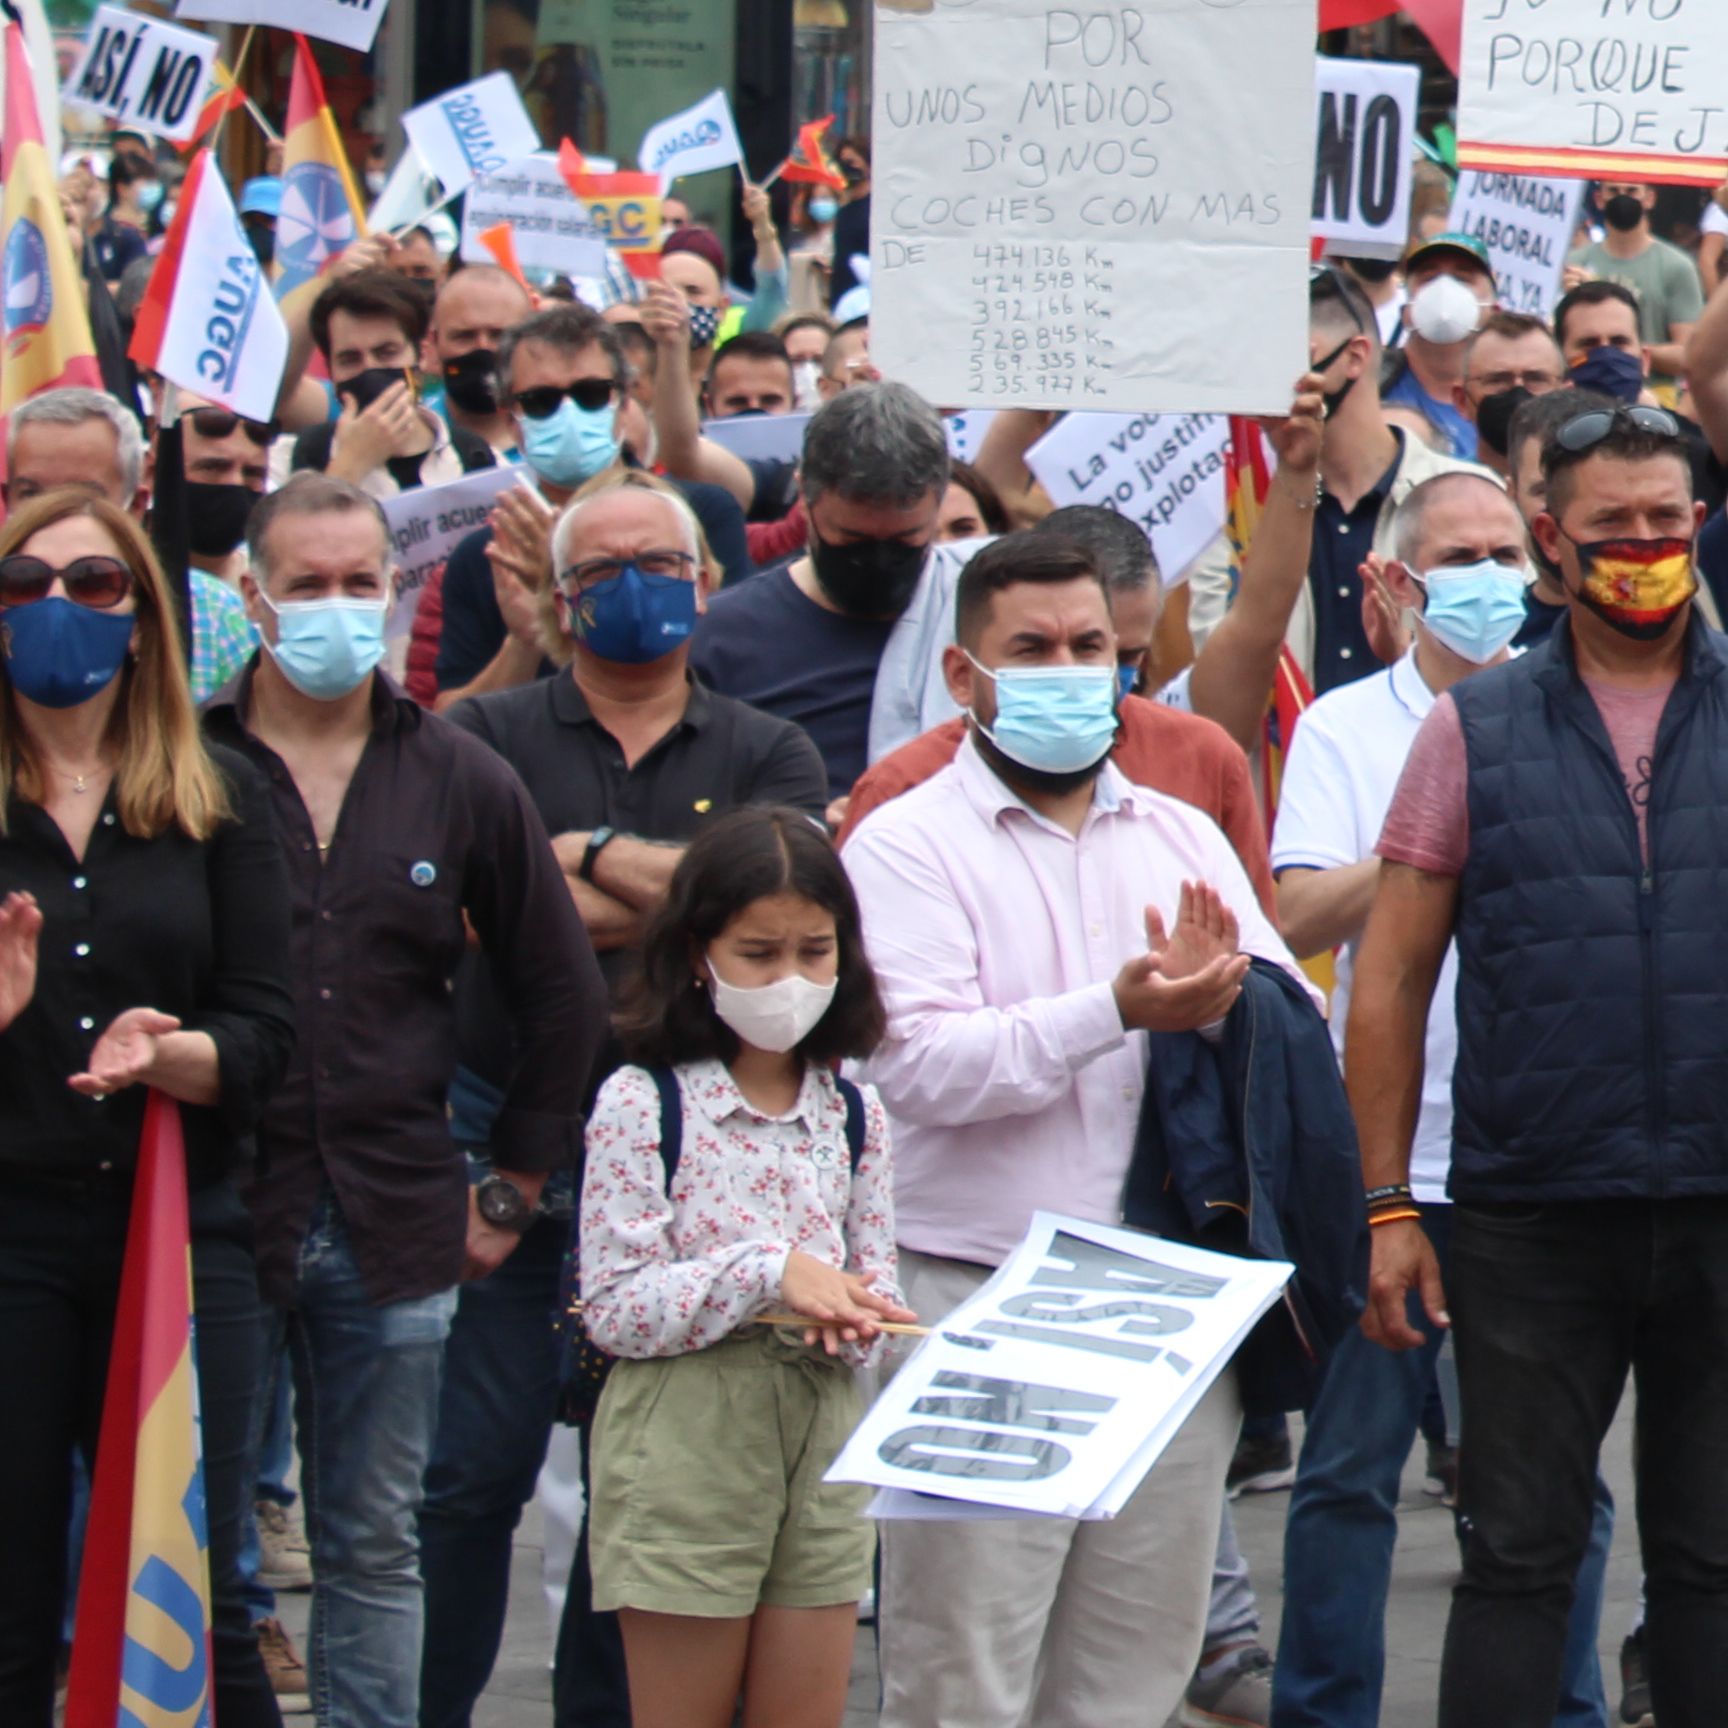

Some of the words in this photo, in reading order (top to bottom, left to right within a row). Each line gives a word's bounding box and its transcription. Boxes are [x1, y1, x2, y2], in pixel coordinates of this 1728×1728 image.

[1044, 8, 1151, 71] POR
[1487, 33, 1690, 94] PORQUE
[137, 45, 204, 129] NO
[886, 83, 985, 129] UNOS
[1018, 80, 1174, 131] MEDIOS
[1311, 90, 1401, 228] NO
[891, 194, 1056, 230] COCHES
[1080, 192, 1169, 226] CON
[1190, 192, 1281, 226] MAS
[1469, 171, 1566, 222] JORNADA
[882, 239, 928, 270] DE
[1462, 209, 1552, 268] LABORAL
[1067, 453, 1109, 492] La
[875, 1369, 1119, 1483] NO
